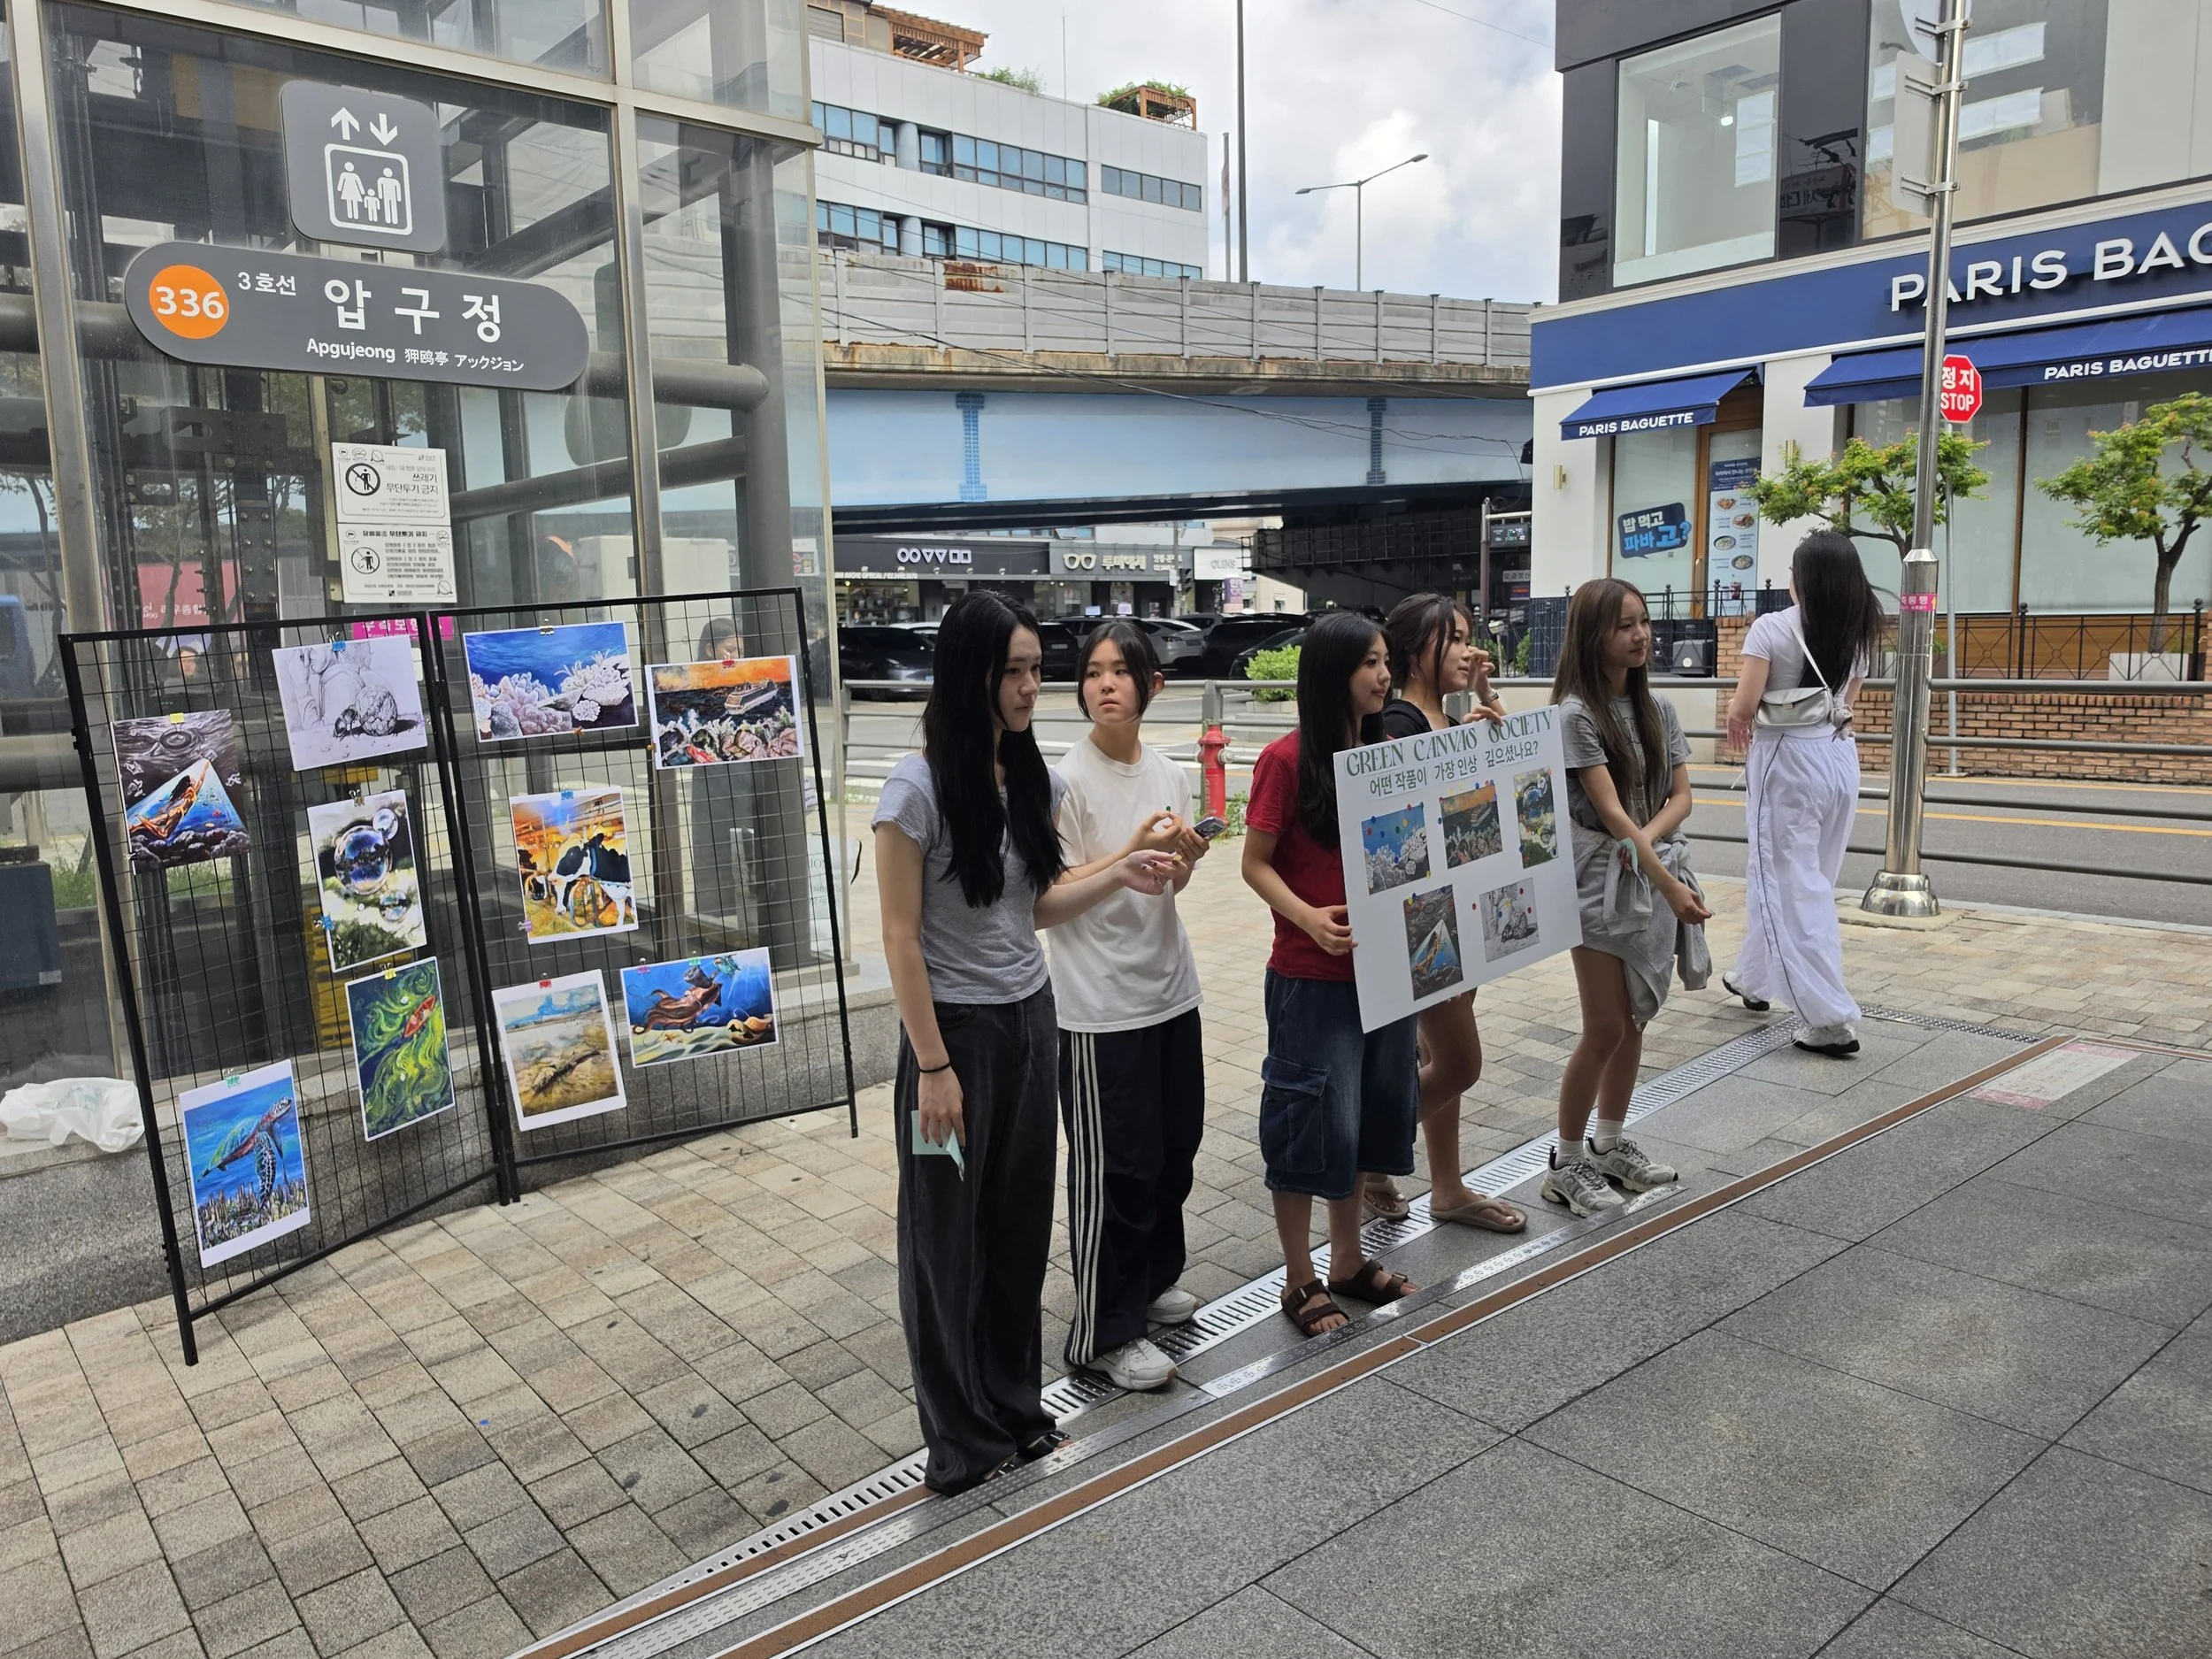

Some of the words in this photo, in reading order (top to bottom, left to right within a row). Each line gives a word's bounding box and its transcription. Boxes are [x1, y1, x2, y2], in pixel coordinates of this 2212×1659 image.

[156, 286, 225, 319] 336
[306, 338, 396, 363] Apgujeong
[1942, 365, 1975, 392] 정지
[2044, 361, 2103, 380] PARIS
[1940, 392, 1975, 411] STOP
[1578, 422, 1617, 436] PARIS
[1621, 412, 1694, 432] BAGUETTE
[386, 483, 419, 494] 무단투기
[421, 484, 439, 495] 금지
[412, 472, 437, 483] 쓰레기
[1623, 517, 1636, 534] 밥
[1638, 511, 1664, 528] 먹고
[1347, 742, 1404, 777] GREEN
[1413, 727, 1478, 762] CANVAS
[1488, 710, 1553, 744] SOCIETY
[1370, 778, 1393, 796] 어떤
[1395, 766, 1427, 789] 작품이
[1434, 761, 1455, 782] 가장
[1457, 756, 1478, 776] 인상
[1485, 740, 1539, 768] 깊으셨나요?
